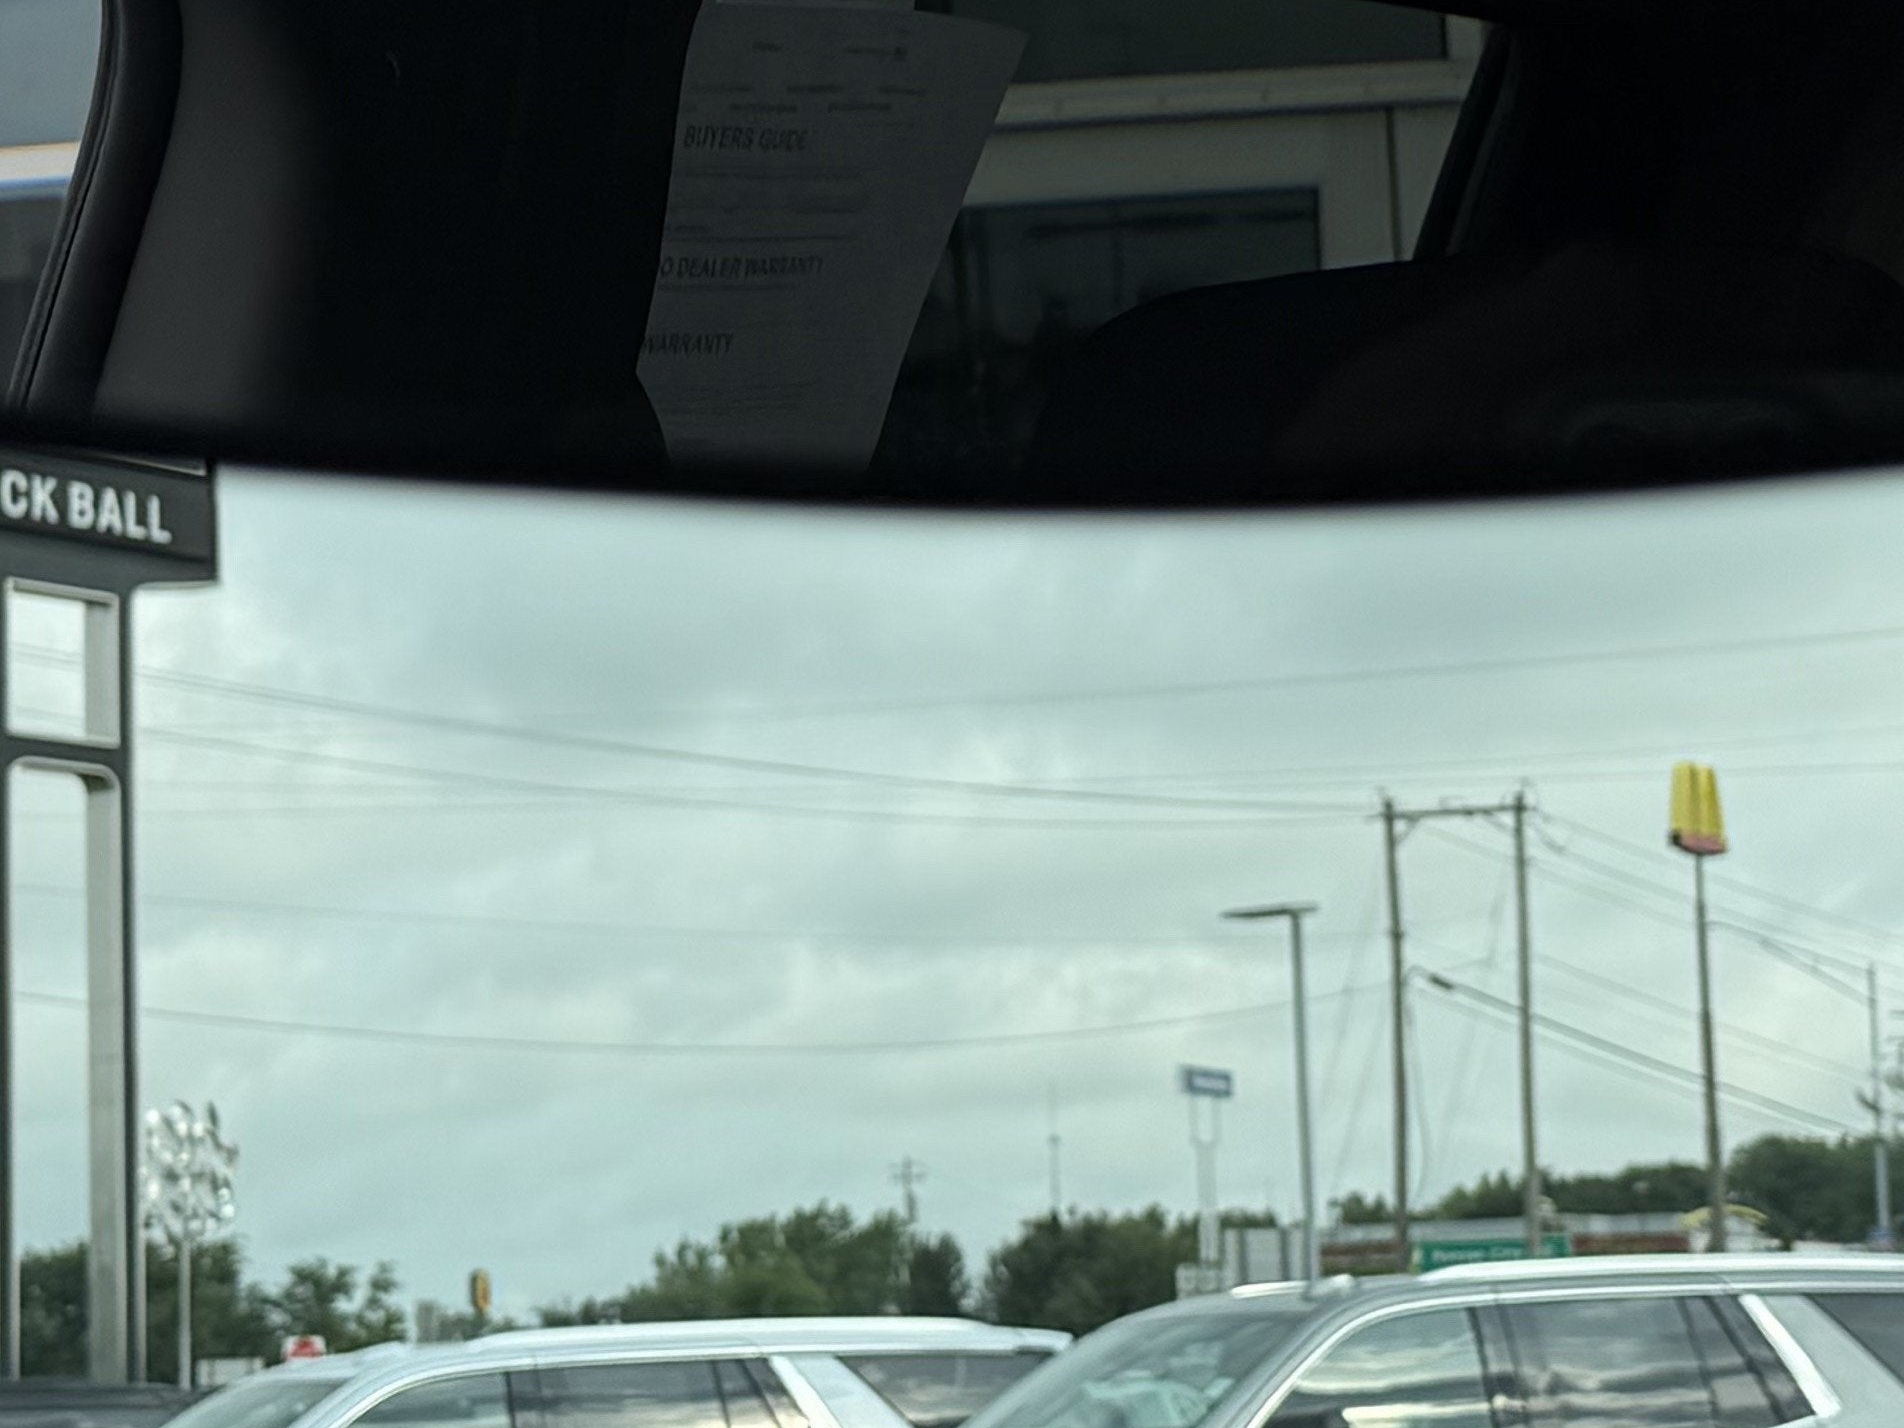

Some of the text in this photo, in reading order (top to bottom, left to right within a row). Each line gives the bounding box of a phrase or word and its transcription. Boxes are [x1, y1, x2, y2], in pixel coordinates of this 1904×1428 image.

[683, 124, 754, 151] BUYERS
[677, 255, 742, 278] DEALER
[66, 478, 174, 545] BALL
